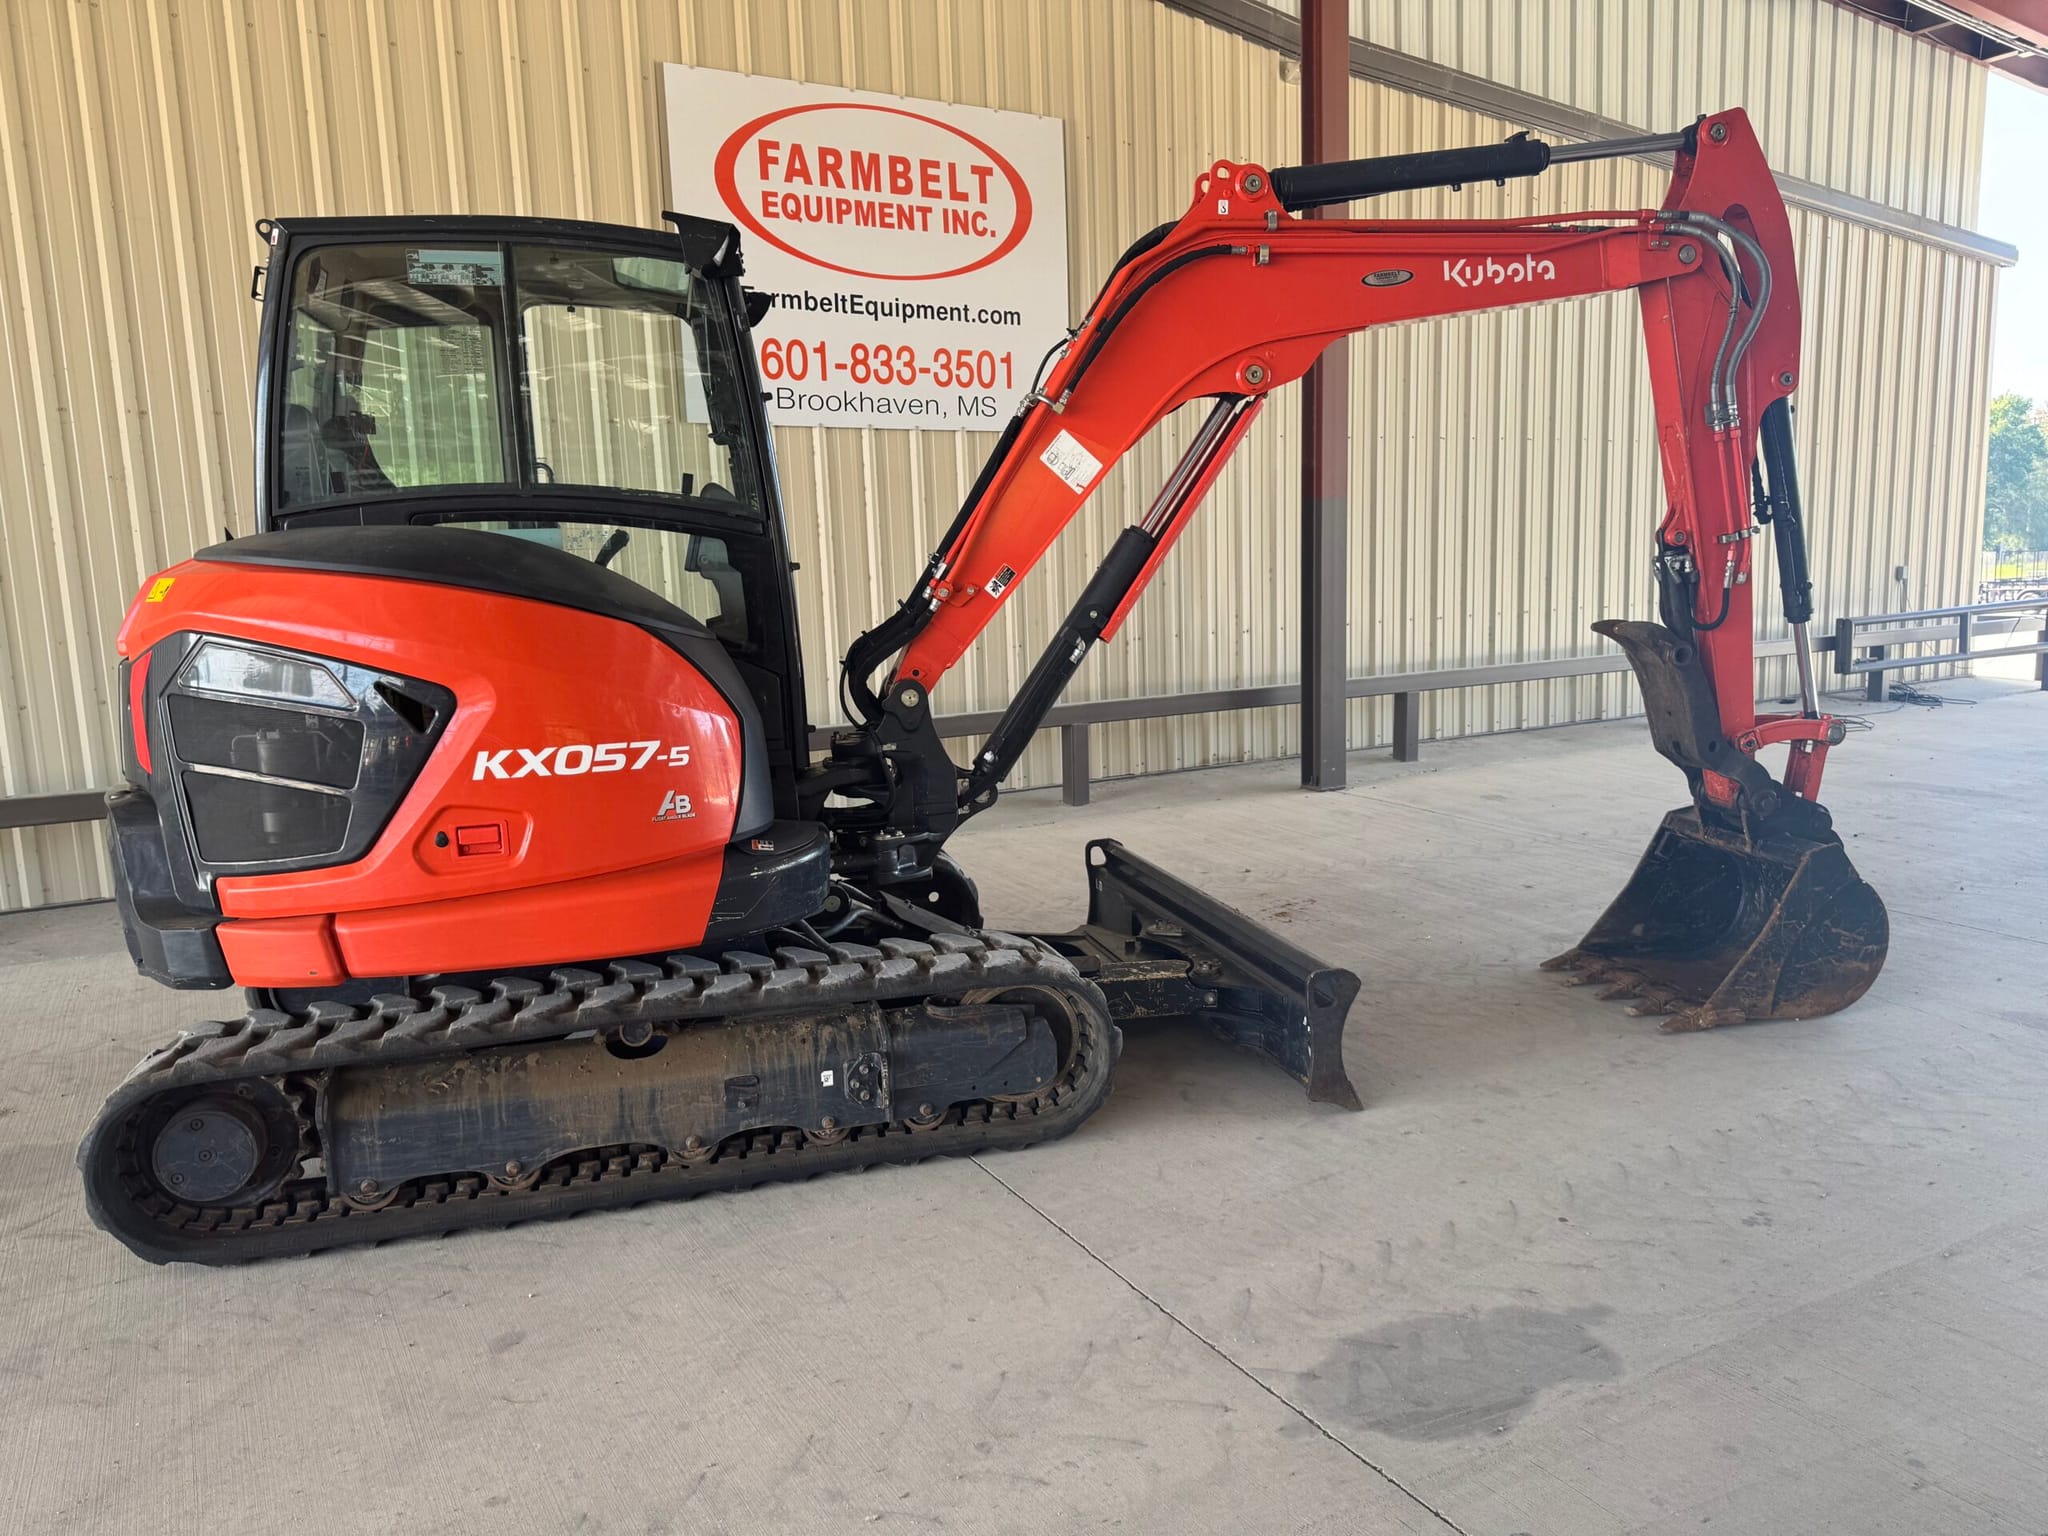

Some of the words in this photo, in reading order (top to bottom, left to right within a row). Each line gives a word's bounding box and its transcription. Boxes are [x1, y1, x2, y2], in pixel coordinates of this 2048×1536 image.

[758, 139, 994, 204] FARMBELT
[761, 190, 933, 232] EQUIPMENT
[942, 208, 996, 238] INC.
[1443, 253, 1556, 288] Kubota
[741, 285, 1022, 326] rmbeltEquipment.com
[761, 338, 1013, 389] 601-833-3501
[776, 387, 948, 419] Brookhaven,
[958, 396, 998, 418] MS
[472, 740, 691, 781] KX057-5
